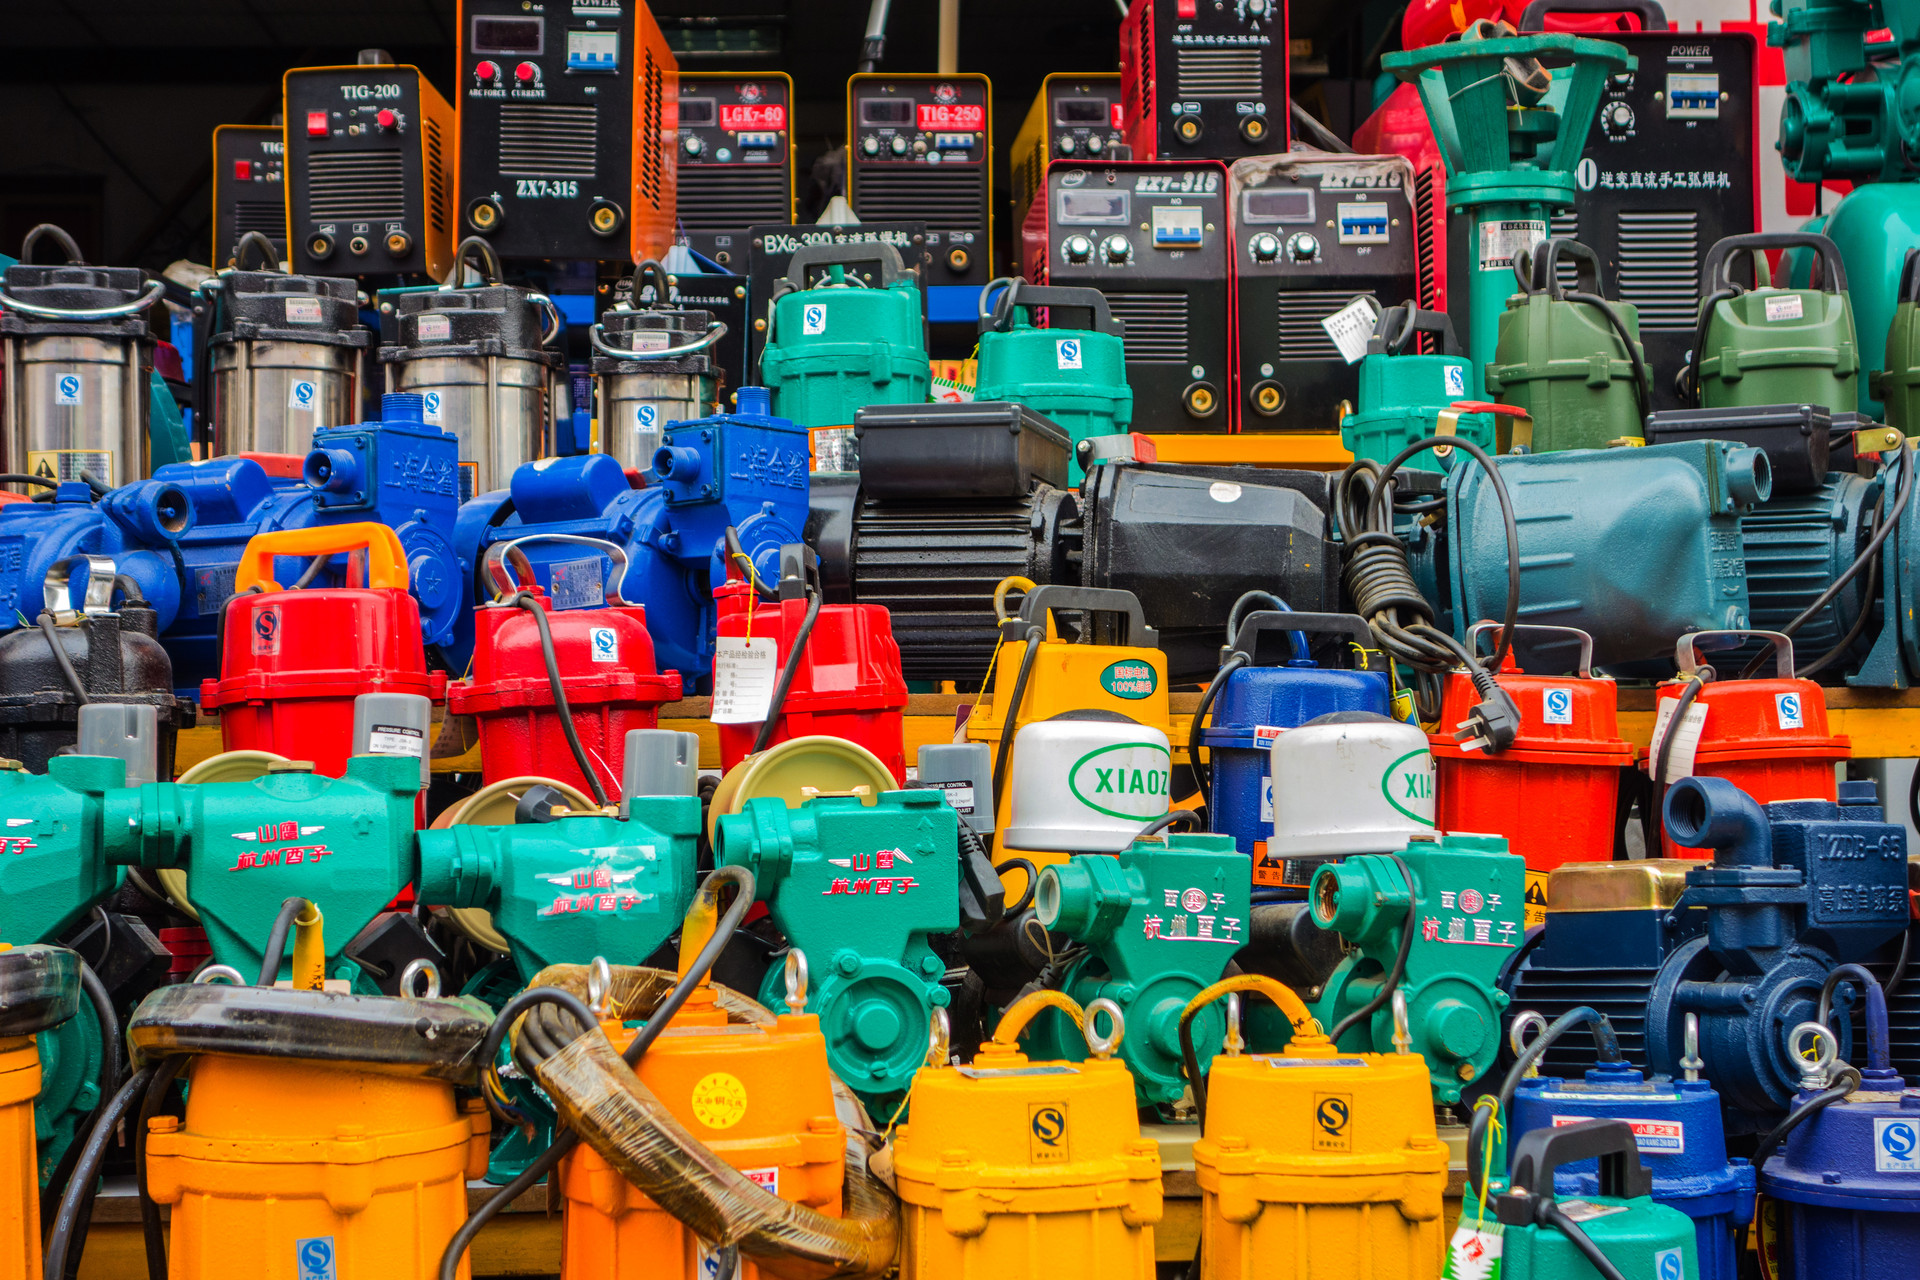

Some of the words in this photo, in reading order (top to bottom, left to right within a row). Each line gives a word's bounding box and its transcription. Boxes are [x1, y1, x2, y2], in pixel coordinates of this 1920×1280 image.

[1671, 45, 1711, 55] POWER
[340, 84, 401, 99] TIG-200
[920, 106, 982, 121] TIG-250
[1135, 171, 1219, 192] ZX7-315
[1574, 158, 1598, 192] 0
[1600, 170, 1731, 190] 逆变直流手工弧焊机
[516, 180, 578, 198] ZX7-315
[1114, 666, 1150, 680] 国标电机
[1094, 768, 1168, 796] XIAOZ
[1404, 774, 1432, 798] XIA
[1258, 870, 1280, 881] 警告
[1636, 1124, 1675, 1136] 小康之宝
[60, 1215, 69, 1232] CCC
